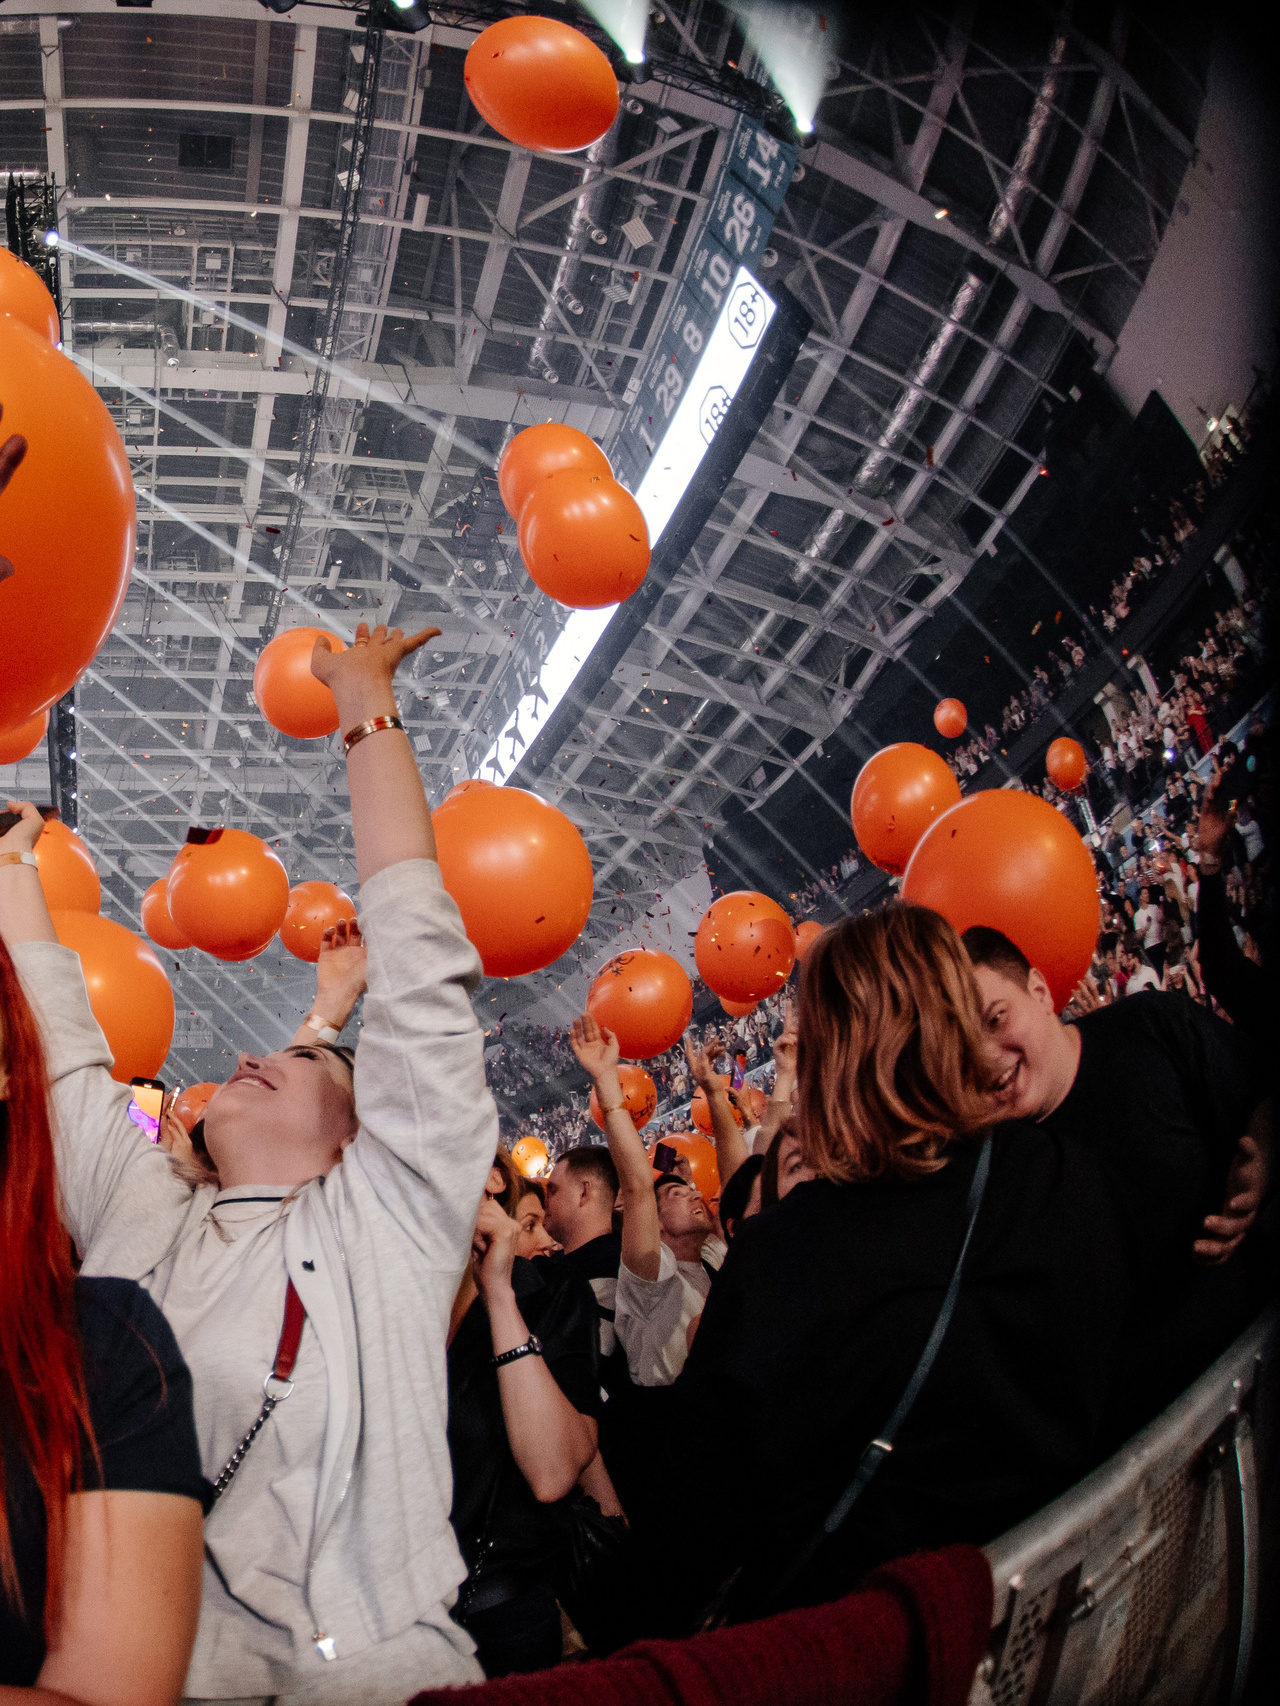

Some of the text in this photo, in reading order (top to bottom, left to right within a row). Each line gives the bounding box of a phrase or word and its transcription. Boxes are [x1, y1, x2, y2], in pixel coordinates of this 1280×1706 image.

[747, 131, 780, 189] 14
[724, 193, 756, 256] 26
[701, 253, 731, 309] 10
[683, 320, 704, 355] 8
[733, 290, 760, 338] 18+
[655, 364, 684, 419] 29
